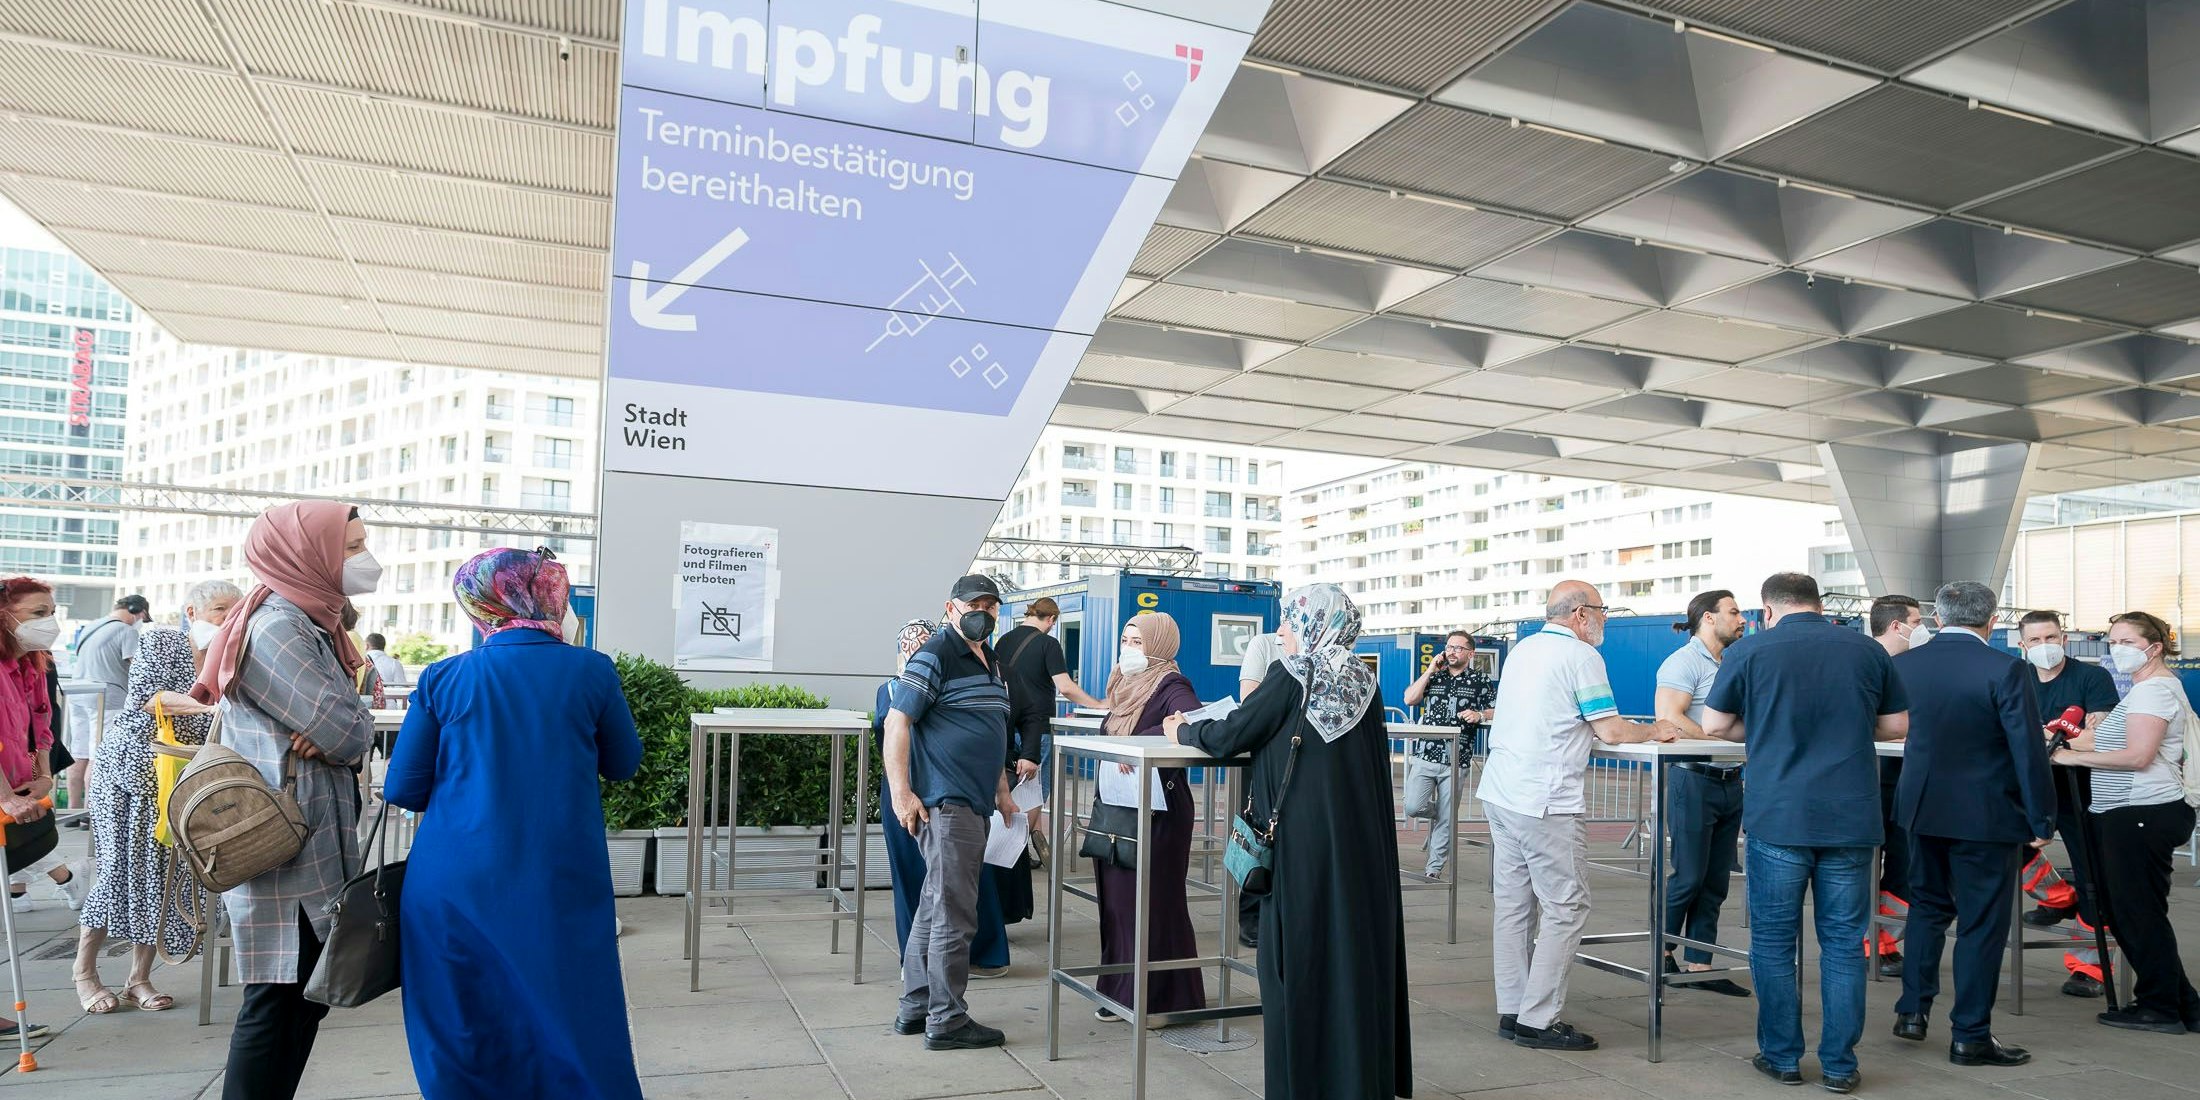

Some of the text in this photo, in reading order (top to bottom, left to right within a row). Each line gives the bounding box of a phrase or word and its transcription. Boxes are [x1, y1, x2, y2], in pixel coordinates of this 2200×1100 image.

[641, 0, 1051, 149] Impfung
[638, 107, 975, 201] Terminbestätigung
[640, 155, 863, 220] bereithalten
[70, 330, 94, 427] STRABAG
[624, 402, 688, 428] Stadt
[623, 426, 686, 451] Wien
[684, 544, 764, 559] Fotografieren
[683, 559, 747, 572] und Filmen
[682, 573, 736, 585] verboten
[2060, 719, 2081, 734] ORF
